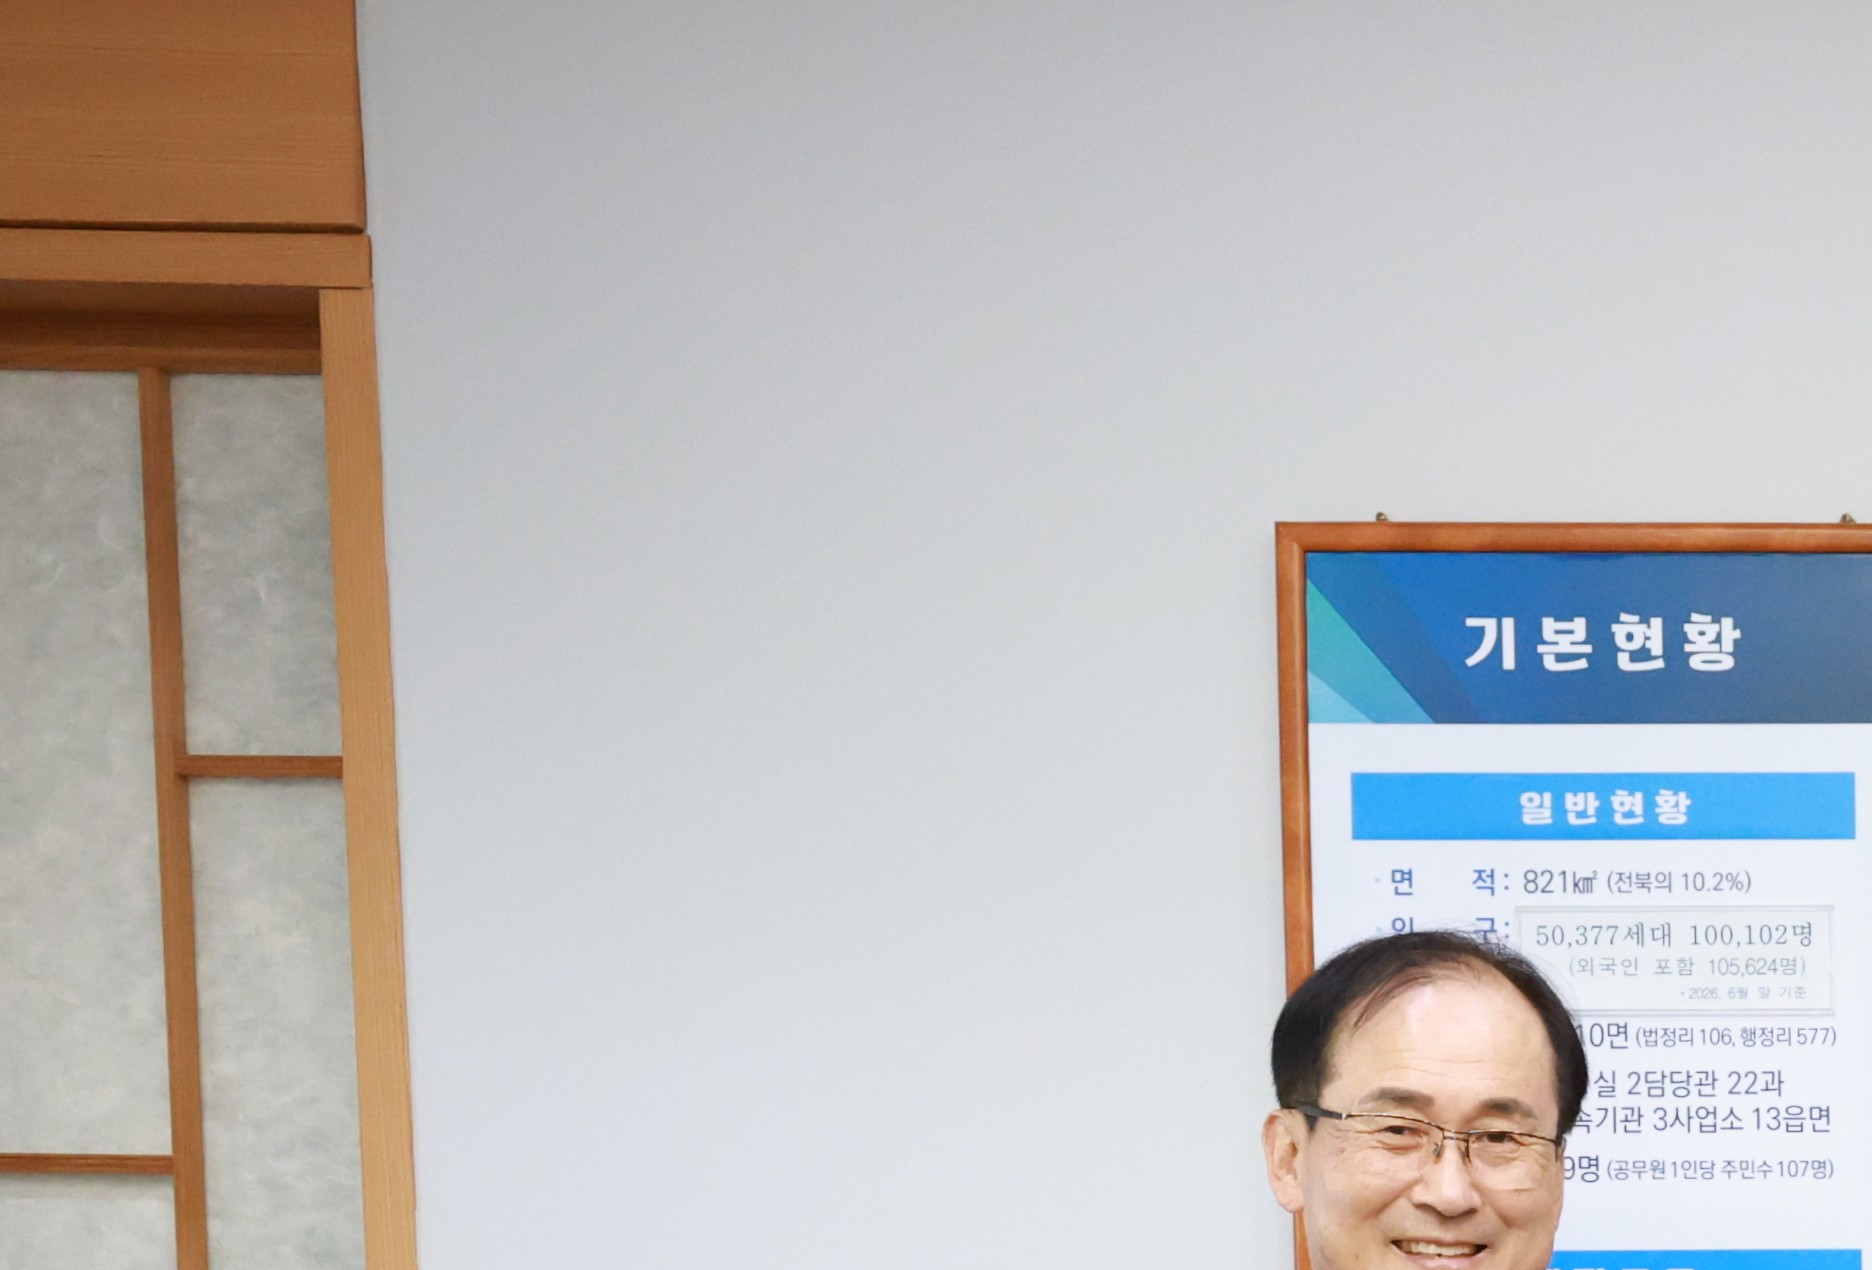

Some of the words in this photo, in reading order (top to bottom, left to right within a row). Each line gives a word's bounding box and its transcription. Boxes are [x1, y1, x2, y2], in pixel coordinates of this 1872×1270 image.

[1464, 611, 1742, 672] 기본현황
[1517, 788, 1693, 827] 일반현황
[1606, 870, 1672, 894] (전북의
[1681, 870, 1752, 894] 10.2%)
[1536, 921, 1672, 949] 50,377세대
[1690, 921, 1812, 948] 100,102명
[1569, 956, 1638, 977] (외국인
[1654, 956, 1695, 977] 포함
[1709, 956, 1806, 977] 105,624명)
[1635, 1027, 1694, 1048] (법정리
[1699, 1027, 1736, 1048] 106,
[1740, 1026, 1792, 1048] 행정리
[1796, 1026, 1837, 1047] 577)
[1627, 1069, 1719, 1099] 2담당관
[1727, 1069, 1785, 1098] 22과
[1653, 1105, 1744, 1134] 3사업소
[1752, 1105, 1831, 1133] 13읍면
[1606, 1159, 1666, 1181] (공무원
[1671, 1159, 1717, 1181] 1인당
[1720, 1159, 1774, 1180] 주민수
[1777, 1159, 1834, 1180] 107명)
